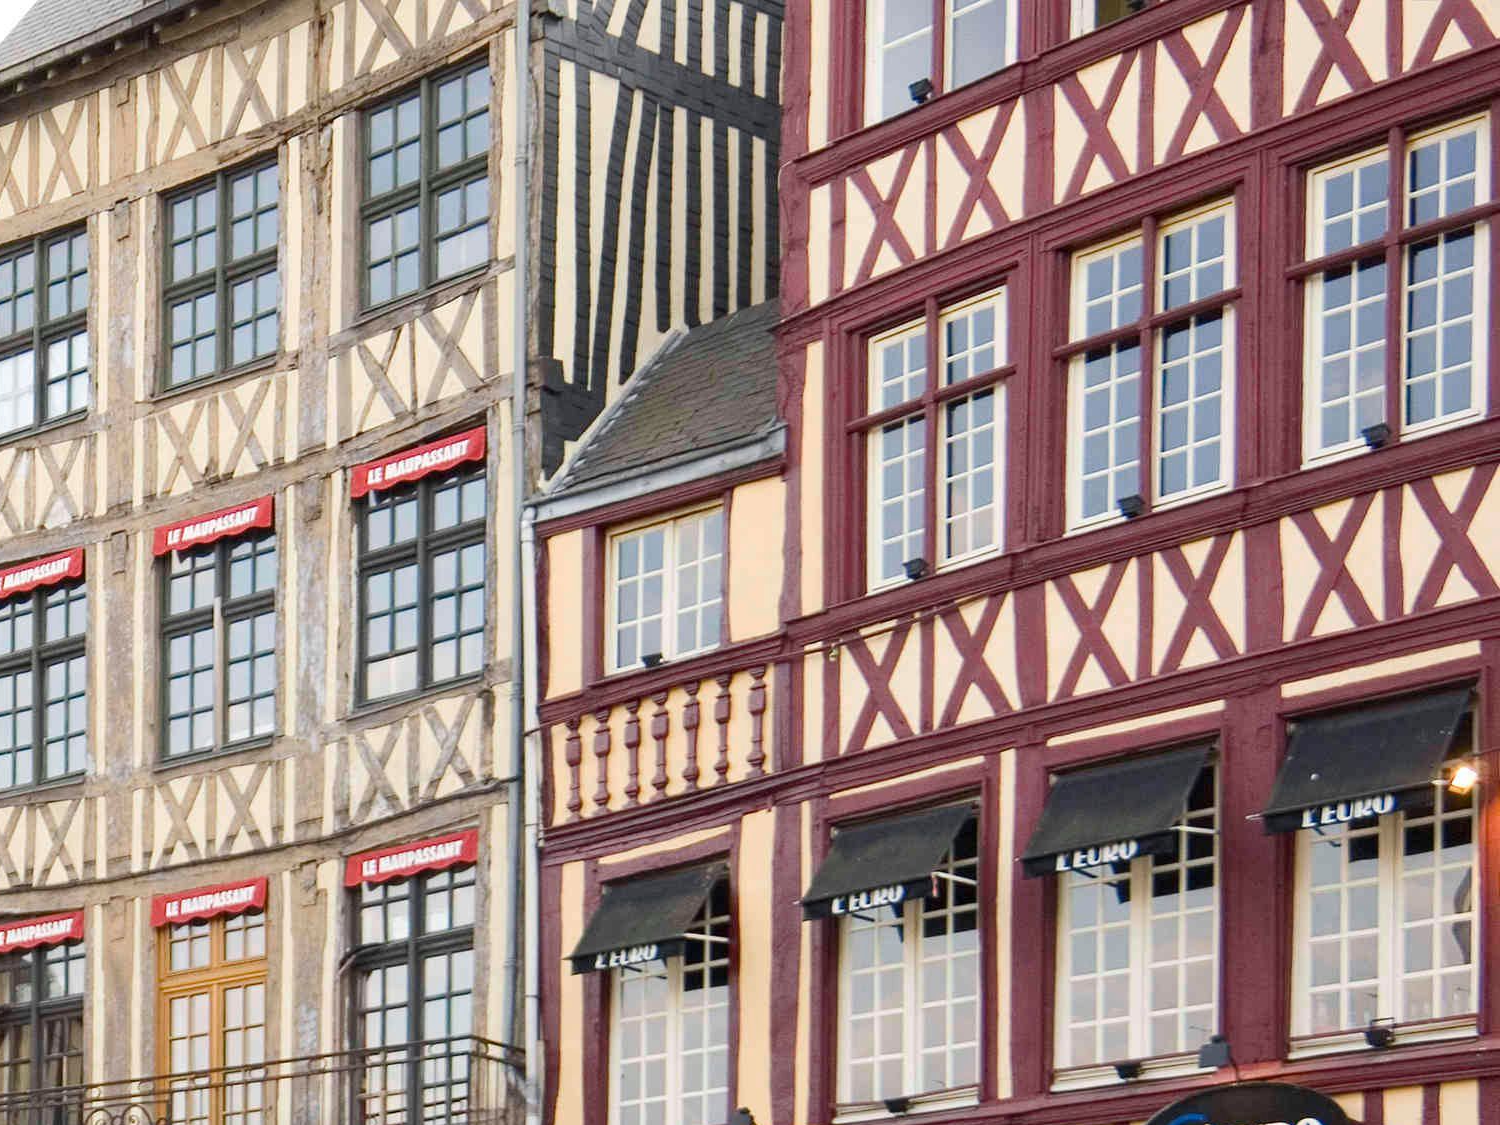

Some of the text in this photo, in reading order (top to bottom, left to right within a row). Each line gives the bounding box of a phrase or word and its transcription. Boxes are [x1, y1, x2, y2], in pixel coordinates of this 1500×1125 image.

[366, 440, 470, 485] LE MAUPASSANT
[167, 506, 258, 546] LE MAUPASSANT
[3, 556, 71, 590] MAUPASSANT
[1301, 794, 1396, 829] L'EURO
[362, 839, 463, 876] LE MAUPASSANT
[1055, 840, 1139, 871] L'EURO
[165, 885, 256, 917] LE MAUPASSANT
[832, 885, 905, 915] L'EURO
[5, 918, 74, 945] MAUPASSANT
[595, 944, 658, 970] L'EURO
